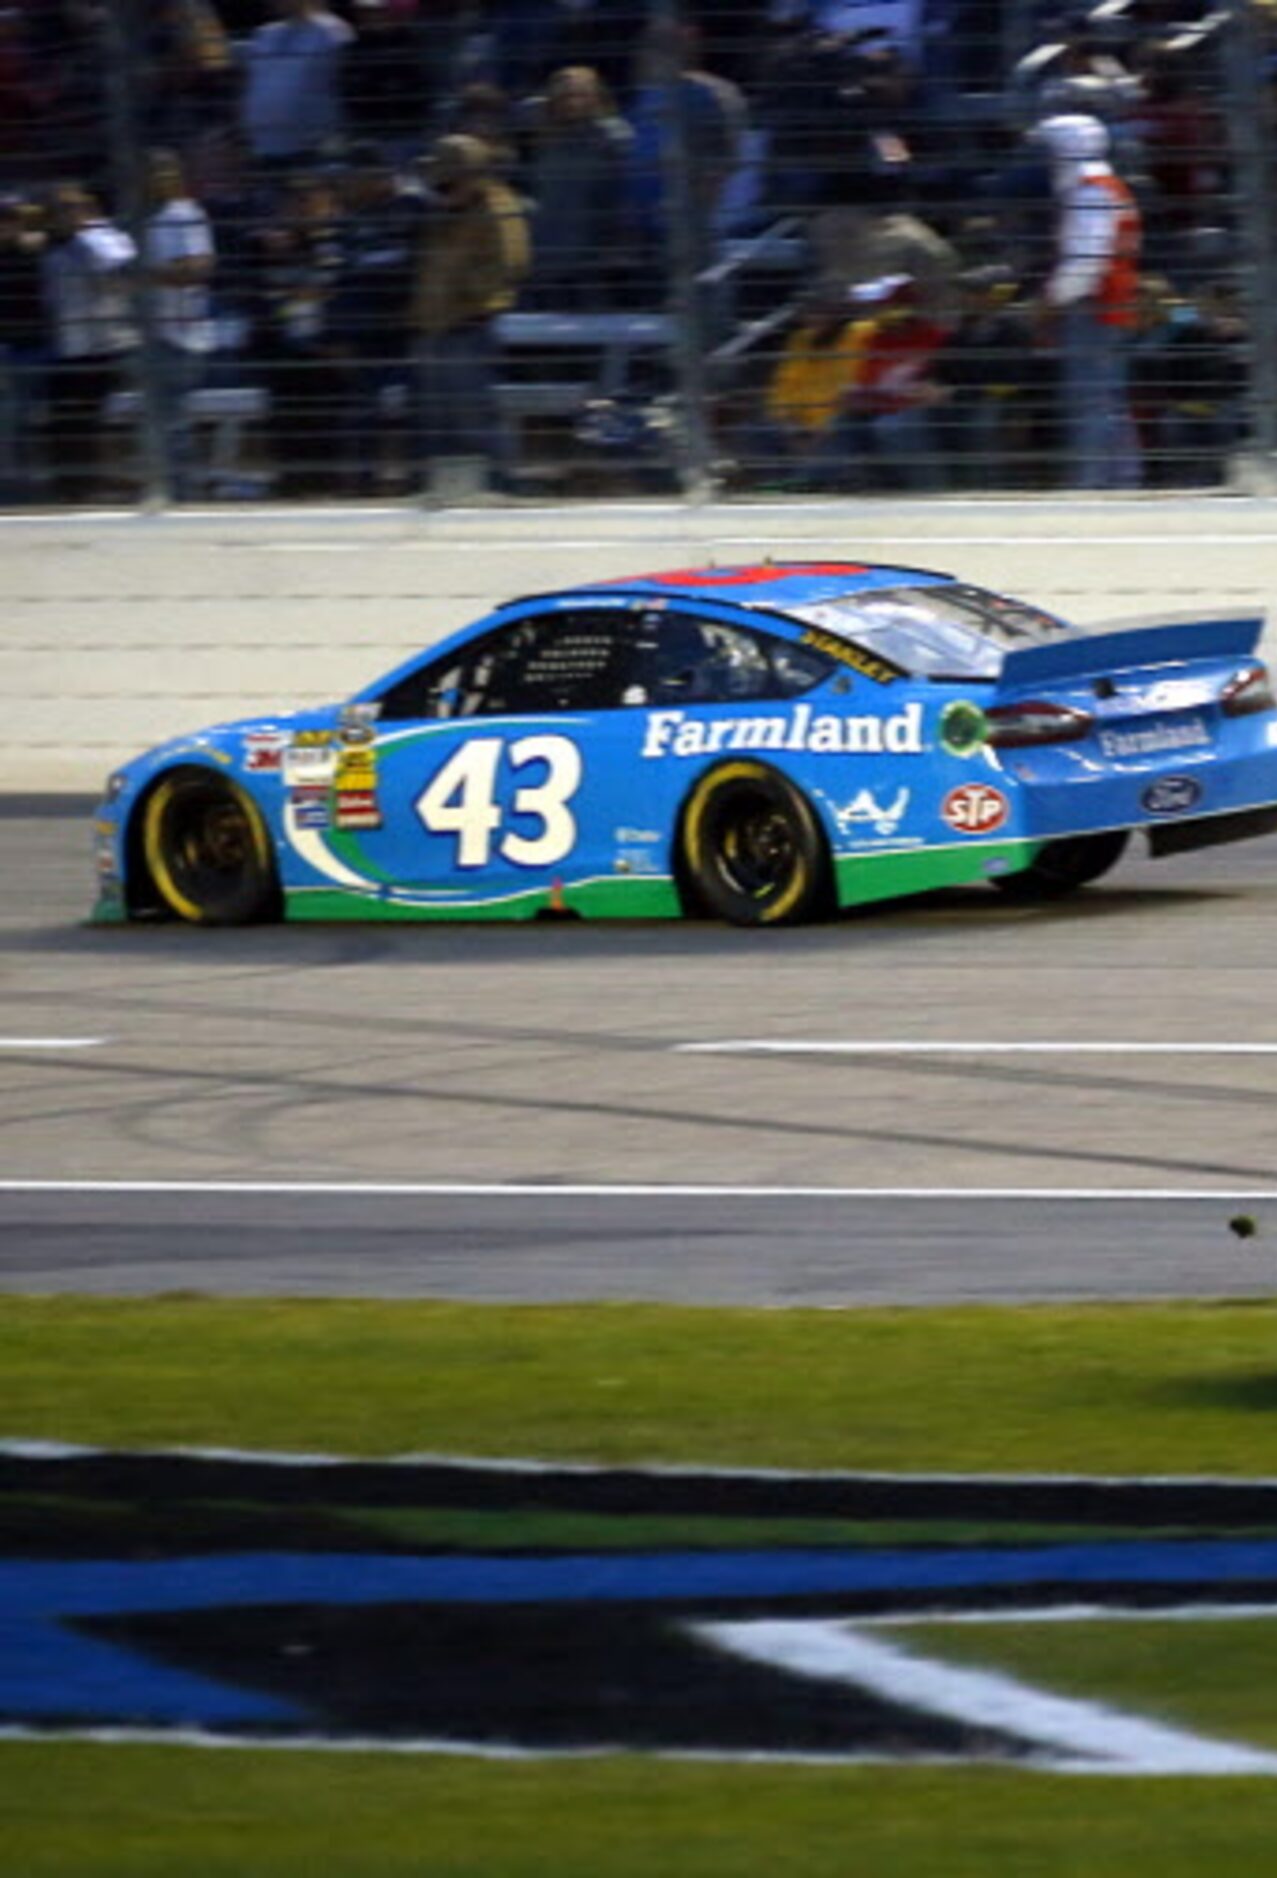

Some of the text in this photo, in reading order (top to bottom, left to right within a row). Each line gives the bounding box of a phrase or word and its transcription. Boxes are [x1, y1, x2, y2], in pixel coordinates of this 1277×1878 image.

[641, 703, 923, 757] Farmland
[1101, 720, 1210, 757] Farmland
[416, 734, 581, 866] 43
[948, 789, 1003, 827] STP
